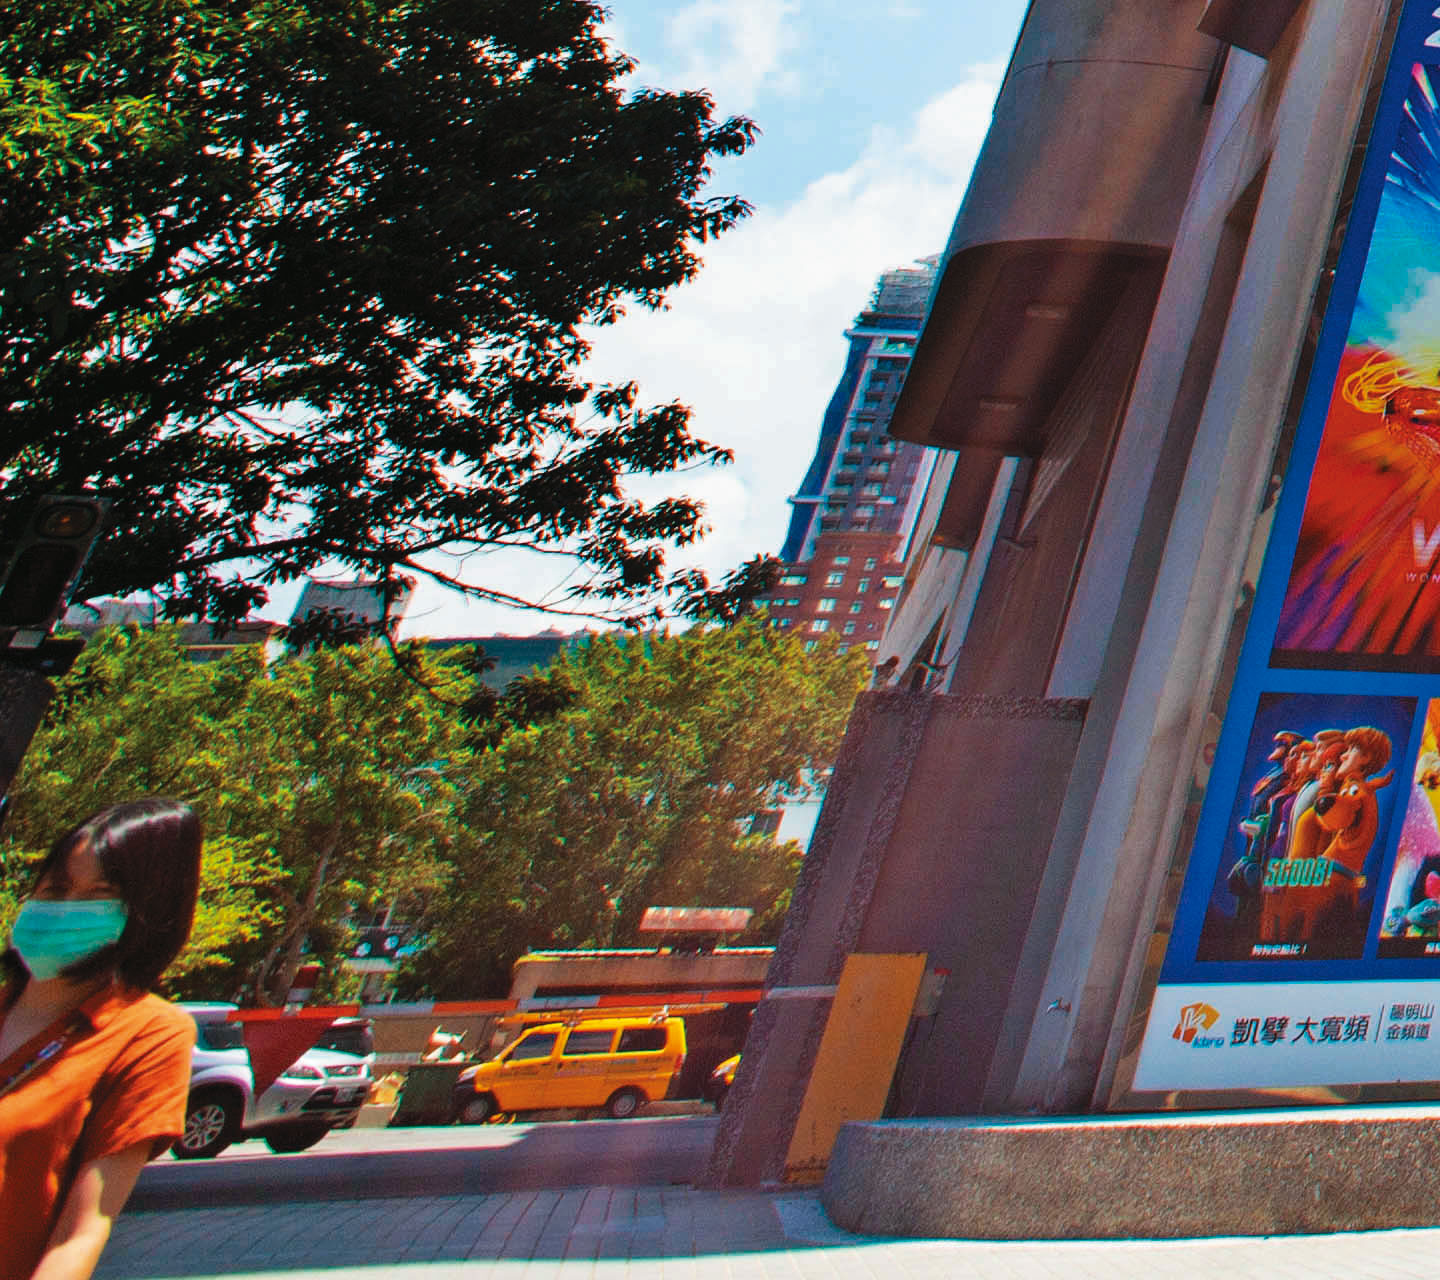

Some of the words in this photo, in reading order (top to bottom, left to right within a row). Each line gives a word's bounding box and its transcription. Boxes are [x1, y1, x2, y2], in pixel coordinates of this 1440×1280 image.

[1230, 1015, 1287, 1046] 凱擘
[1293, 1015, 1371, 1044] 大寬頻
[1385, 1021, 1431, 1040] 金頻道
